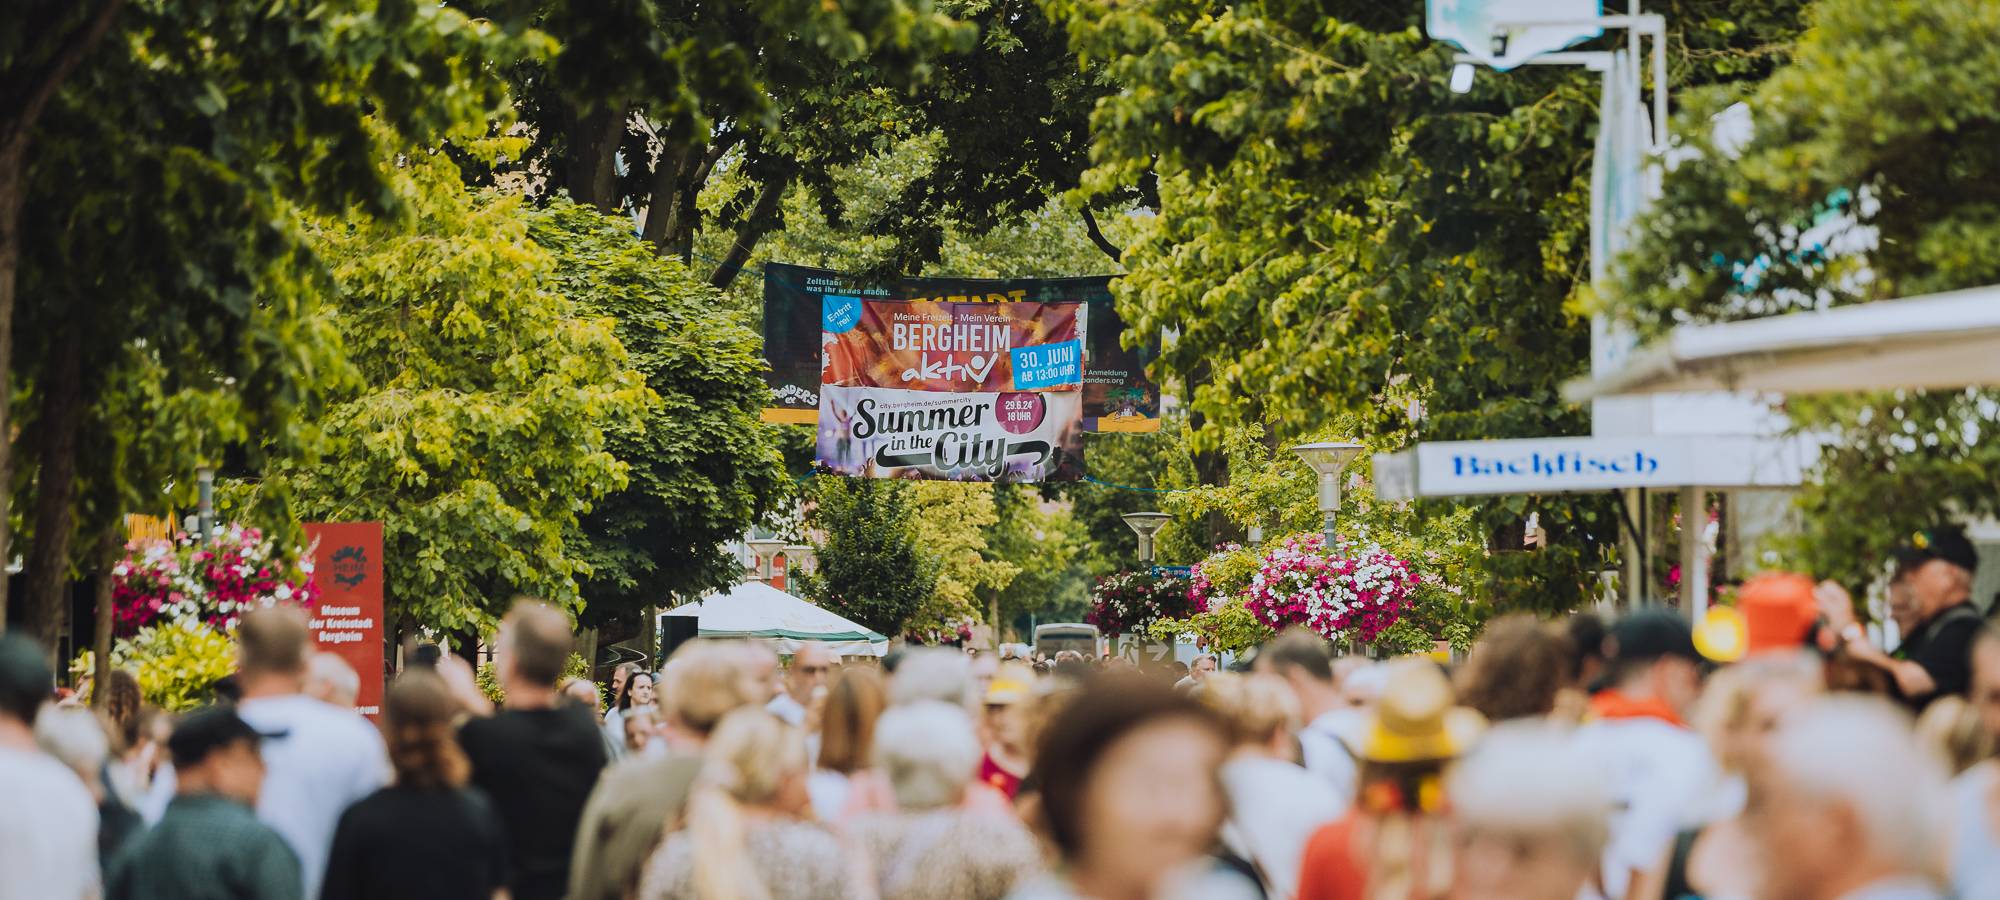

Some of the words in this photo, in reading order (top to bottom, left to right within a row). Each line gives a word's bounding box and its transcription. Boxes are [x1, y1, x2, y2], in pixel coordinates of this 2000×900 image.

[806, 285, 822, 293] was
[893, 313, 920, 321] Meine
[960, 313, 982, 323] Mein
[984, 312, 1011, 323] Verein
[893, 323, 1011, 352] BERGHEIM
[1020, 351, 1042, 369] 30.
[1047, 346, 1074, 366] JUNI
[1021, 371, 1033, 383] AB
[1036, 367, 1058, 381] 13:00
[1060, 364, 1076, 376] UHR
[1088, 368, 1128, 379] Anmeldung
[1005, 400, 1033, 410] 29.6.24
[853, 399, 990, 439] Summer
[1007, 412, 1016, 422] 18
[1017, 411, 1032, 421] UHR
[891, 435, 905, 451] in
[910, 434, 933, 449] the
[935, 431, 1006, 478] City
[1453, 452, 1658, 477] Backfisch
[321, 604, 360, 616] Museum
[326, 617, 373, 629] Kreisstadt
[319, 630, 363, 644] Bergheim
